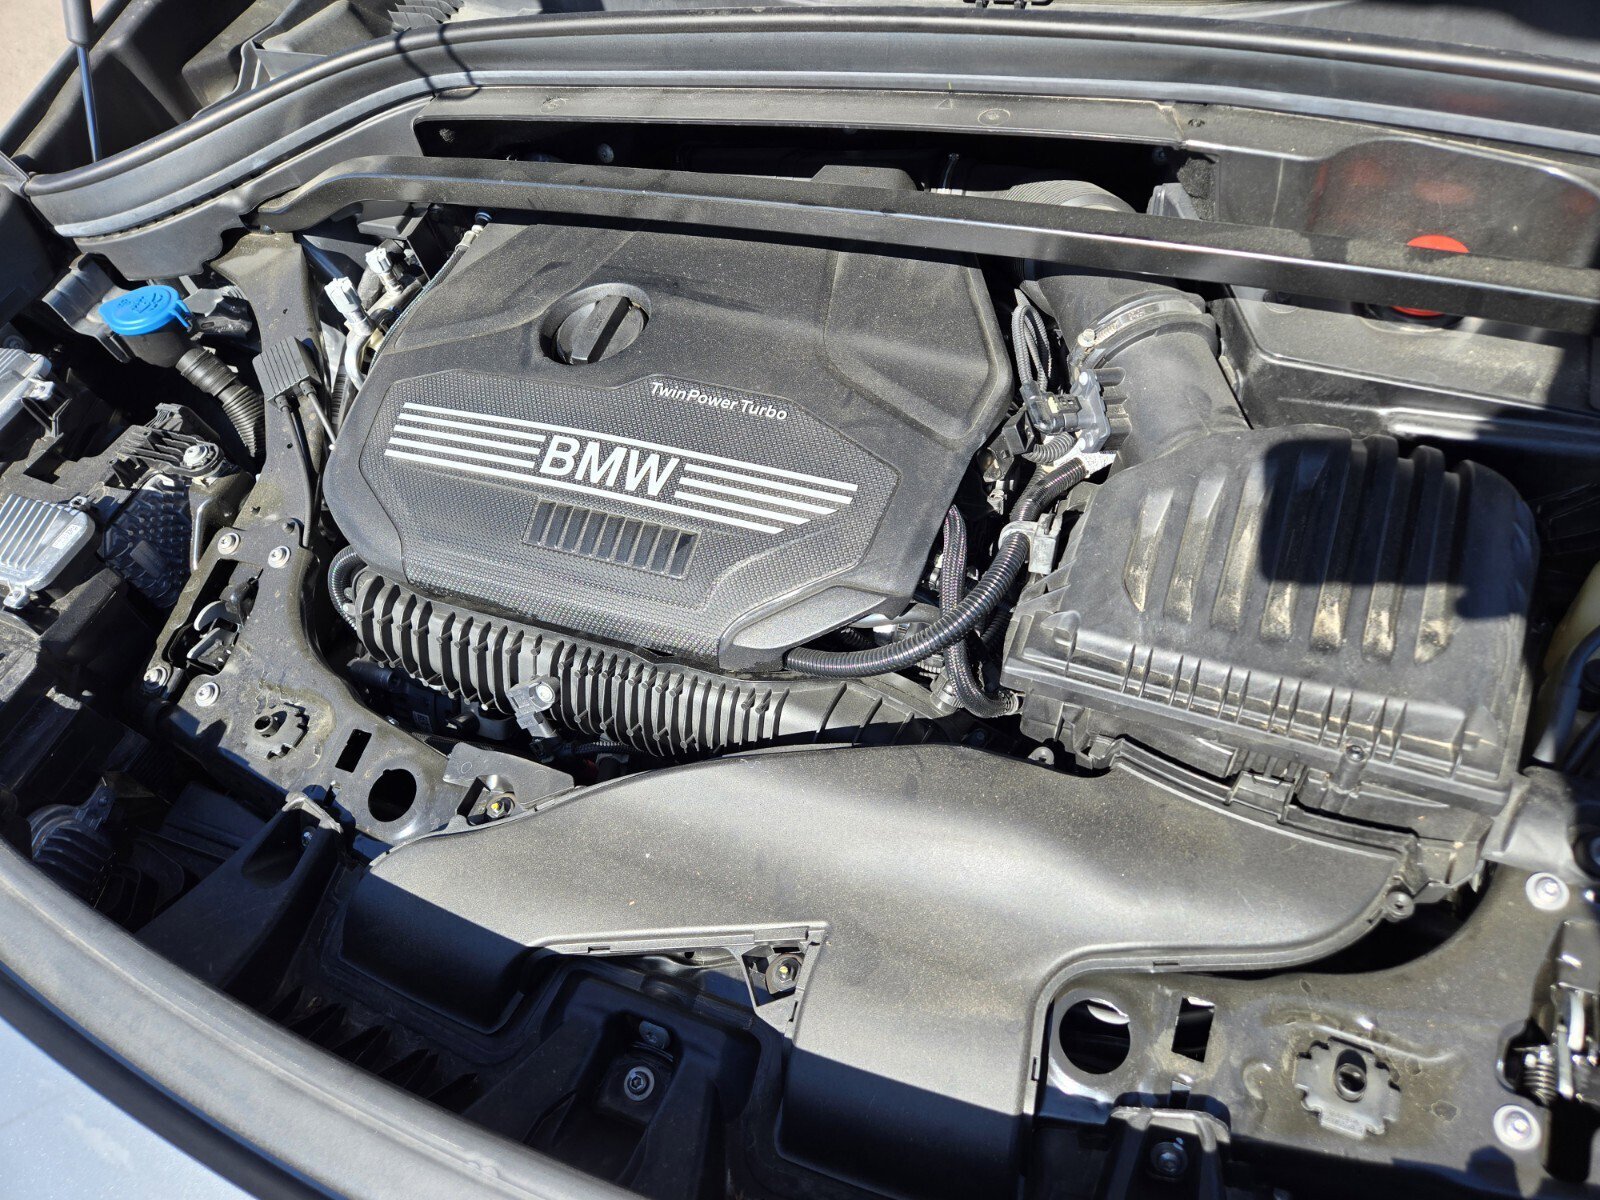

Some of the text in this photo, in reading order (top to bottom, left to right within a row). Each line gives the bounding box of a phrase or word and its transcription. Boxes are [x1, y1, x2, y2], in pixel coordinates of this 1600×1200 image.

[651, 381, 788, 420] TwinPower Turbo
[539, 434, 680, 497] BMW
